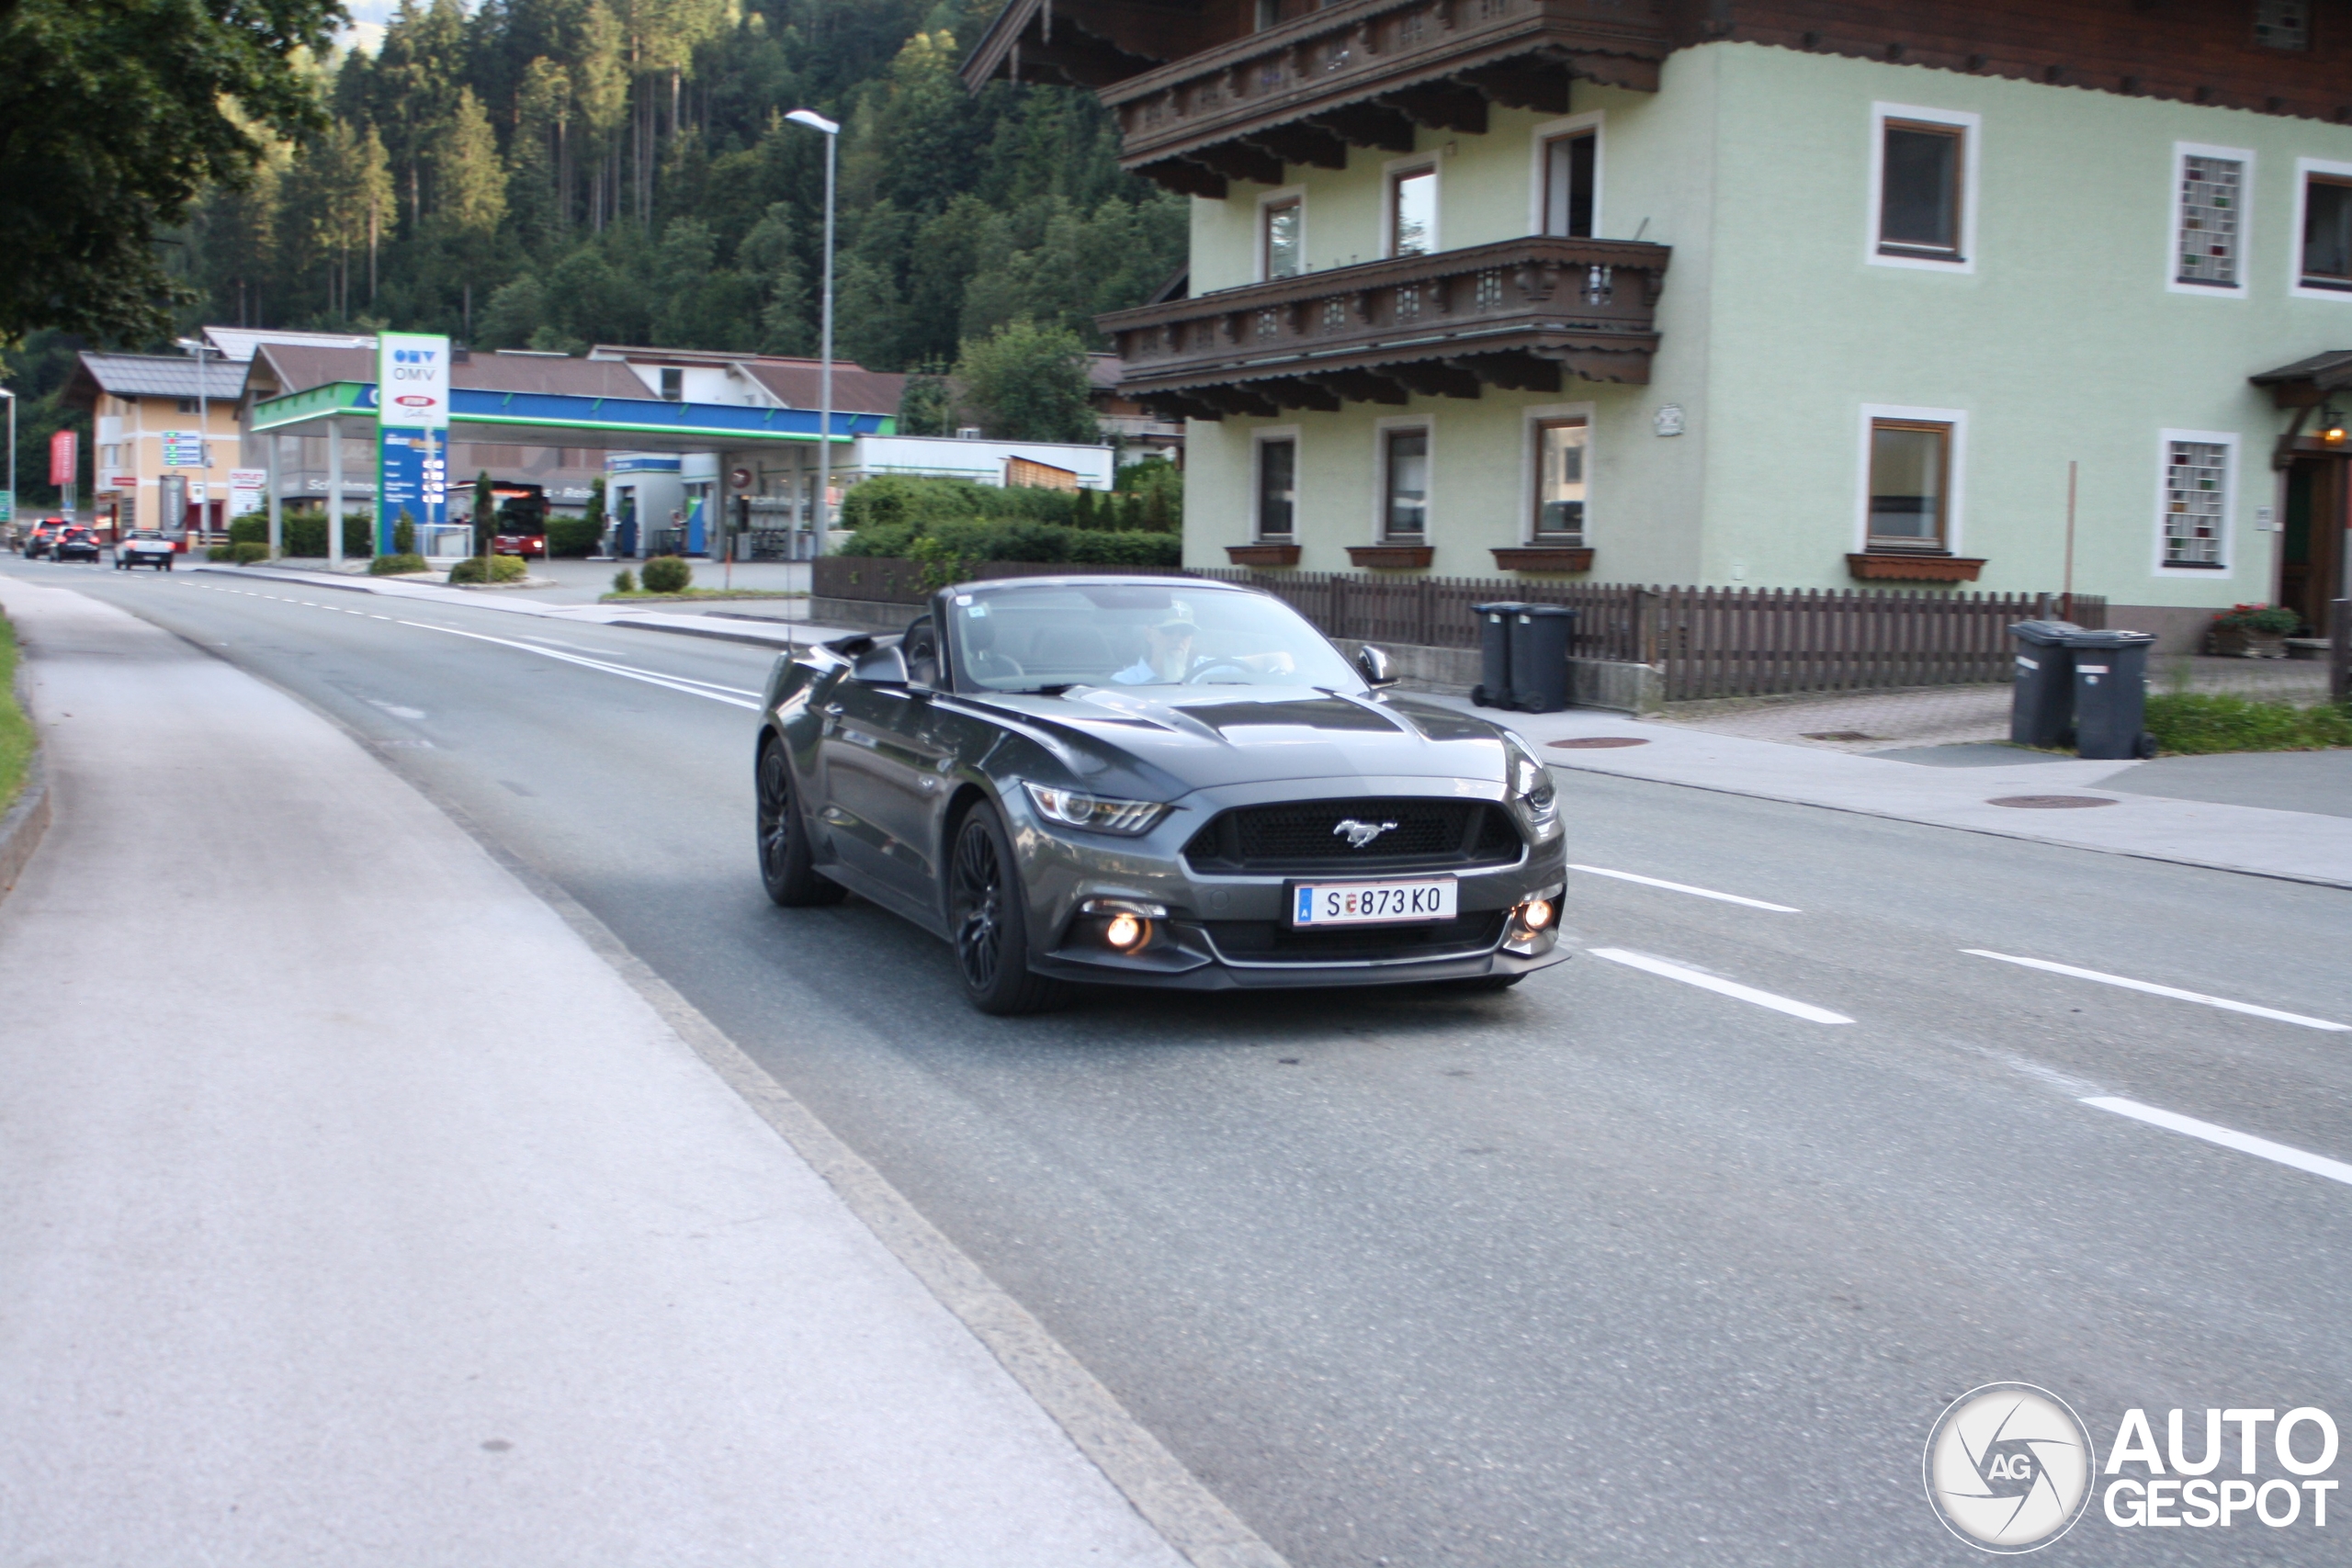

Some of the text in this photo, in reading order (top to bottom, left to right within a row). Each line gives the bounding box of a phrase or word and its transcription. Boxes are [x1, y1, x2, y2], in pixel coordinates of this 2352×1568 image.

[394, 367, 436, 381] OMV
[1327, 892, 1340, 917] S
[1361, 889, 1405, 916] 873
[1301, 908, 1308, 918] A
